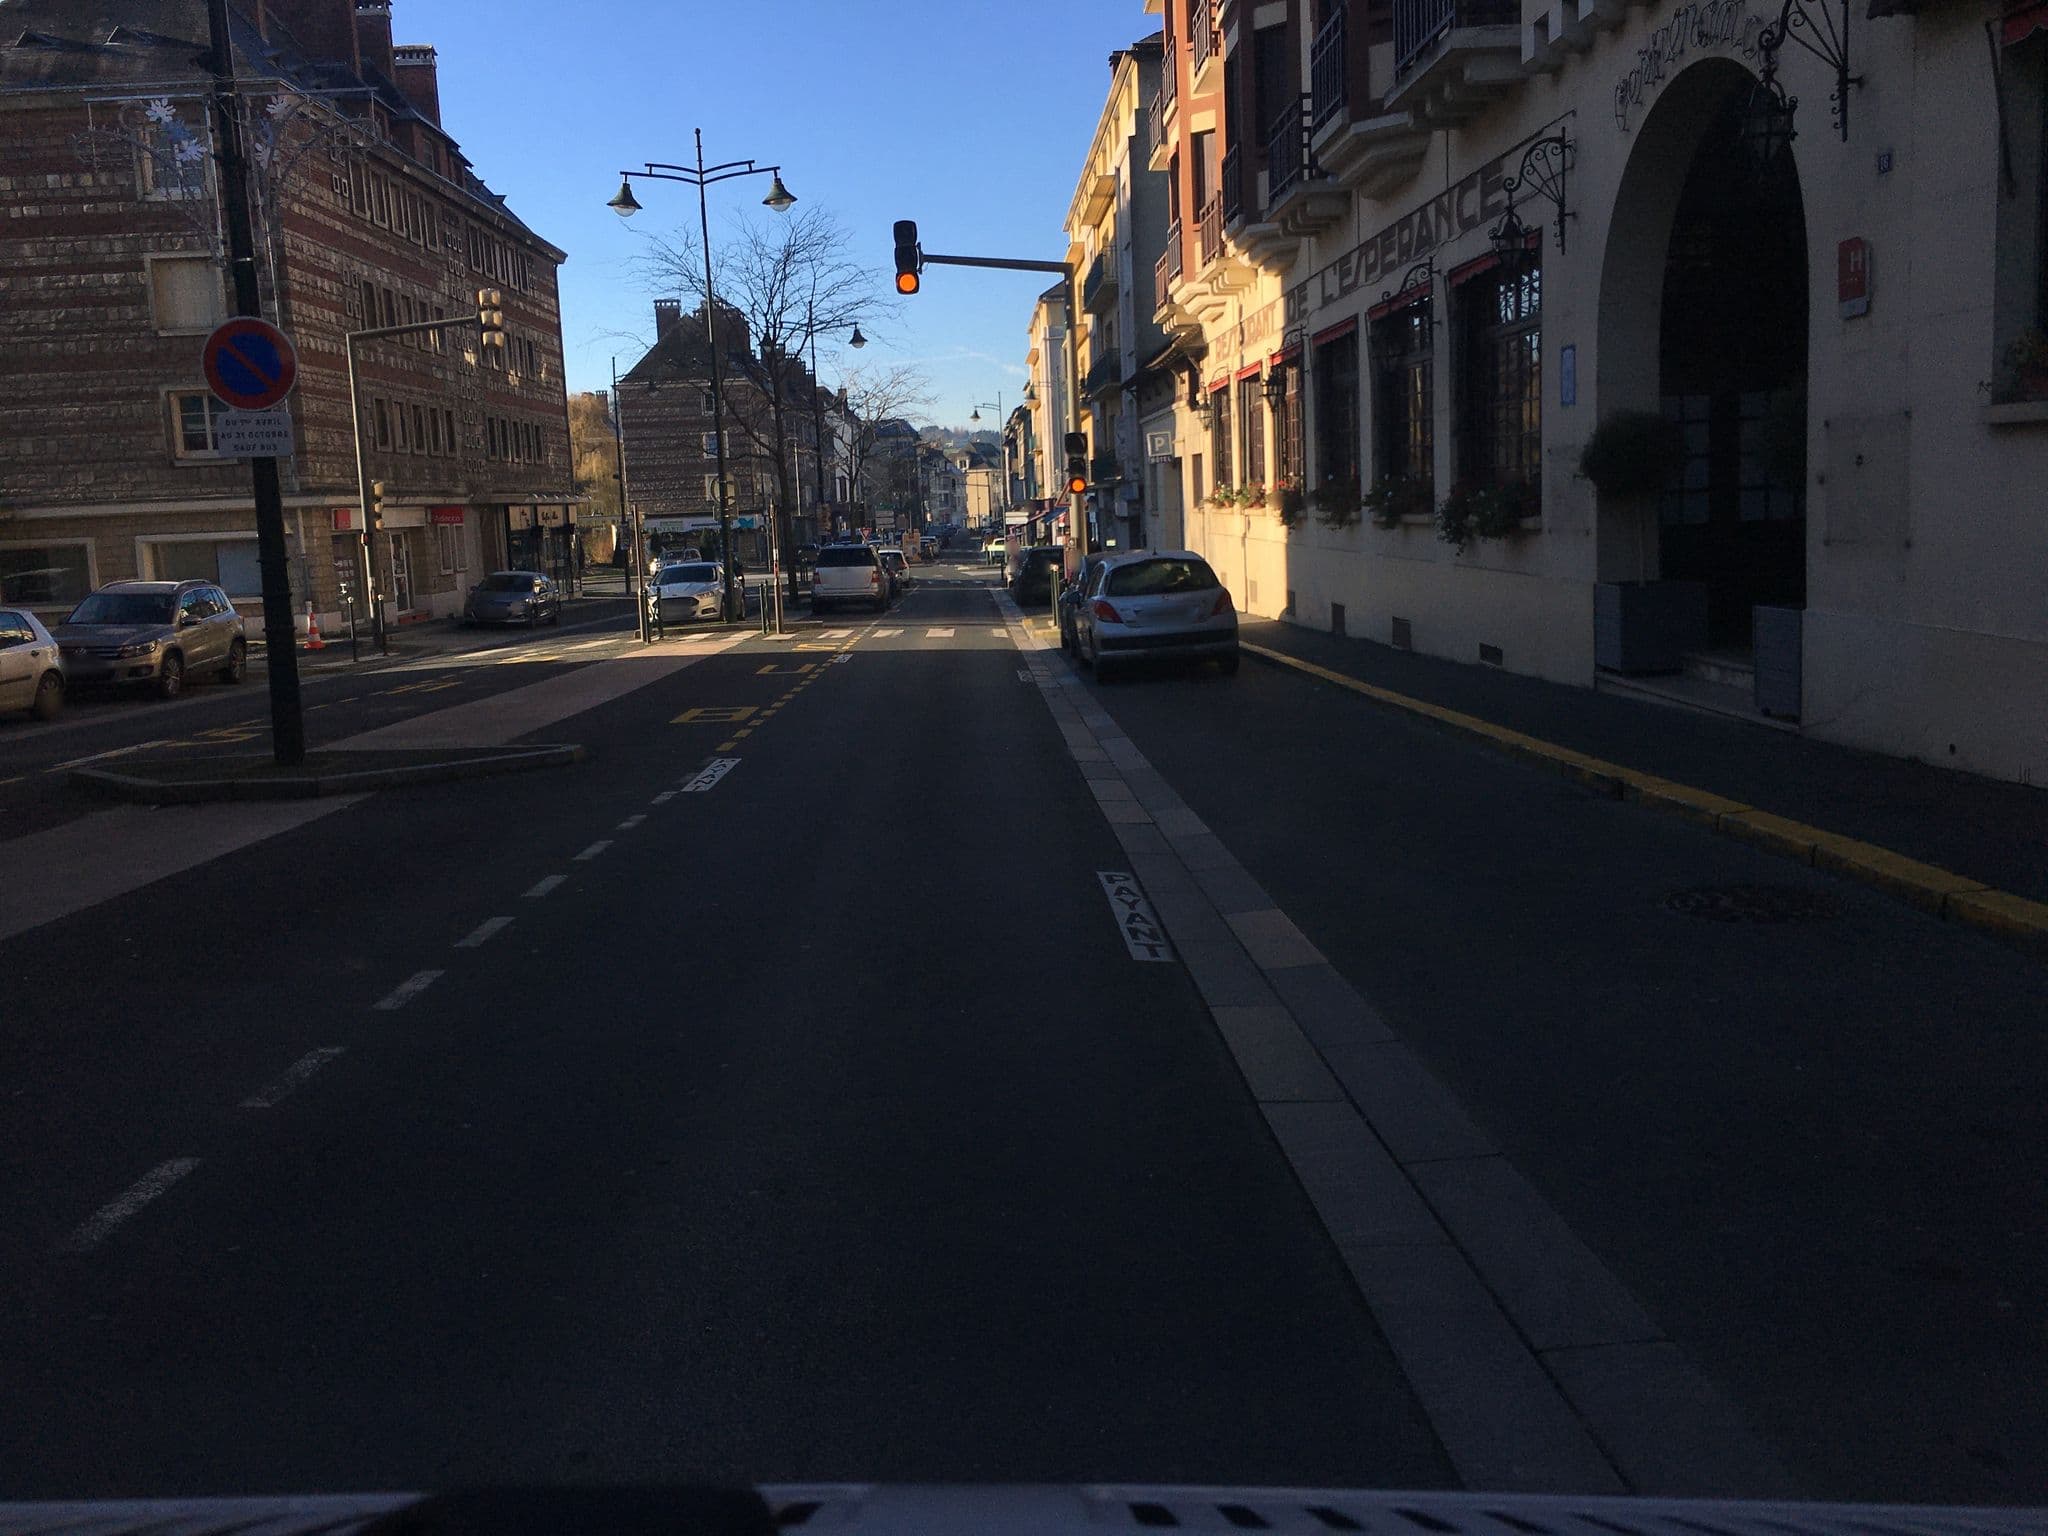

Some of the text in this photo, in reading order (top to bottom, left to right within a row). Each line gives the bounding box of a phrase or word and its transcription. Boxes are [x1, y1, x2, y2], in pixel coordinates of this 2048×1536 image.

[1216, 301, 1277, 363] RESTRANT
[1286, 283, 1307, 324] DE
[255, 418, 282, 426] AVRIL
[220, 431, 233, 439] AU
[233, 443, 278, 452] SAUF BUS
[1154, 436, 1165, 452] P
[1101, 873, 1167, 959] PAYANT
